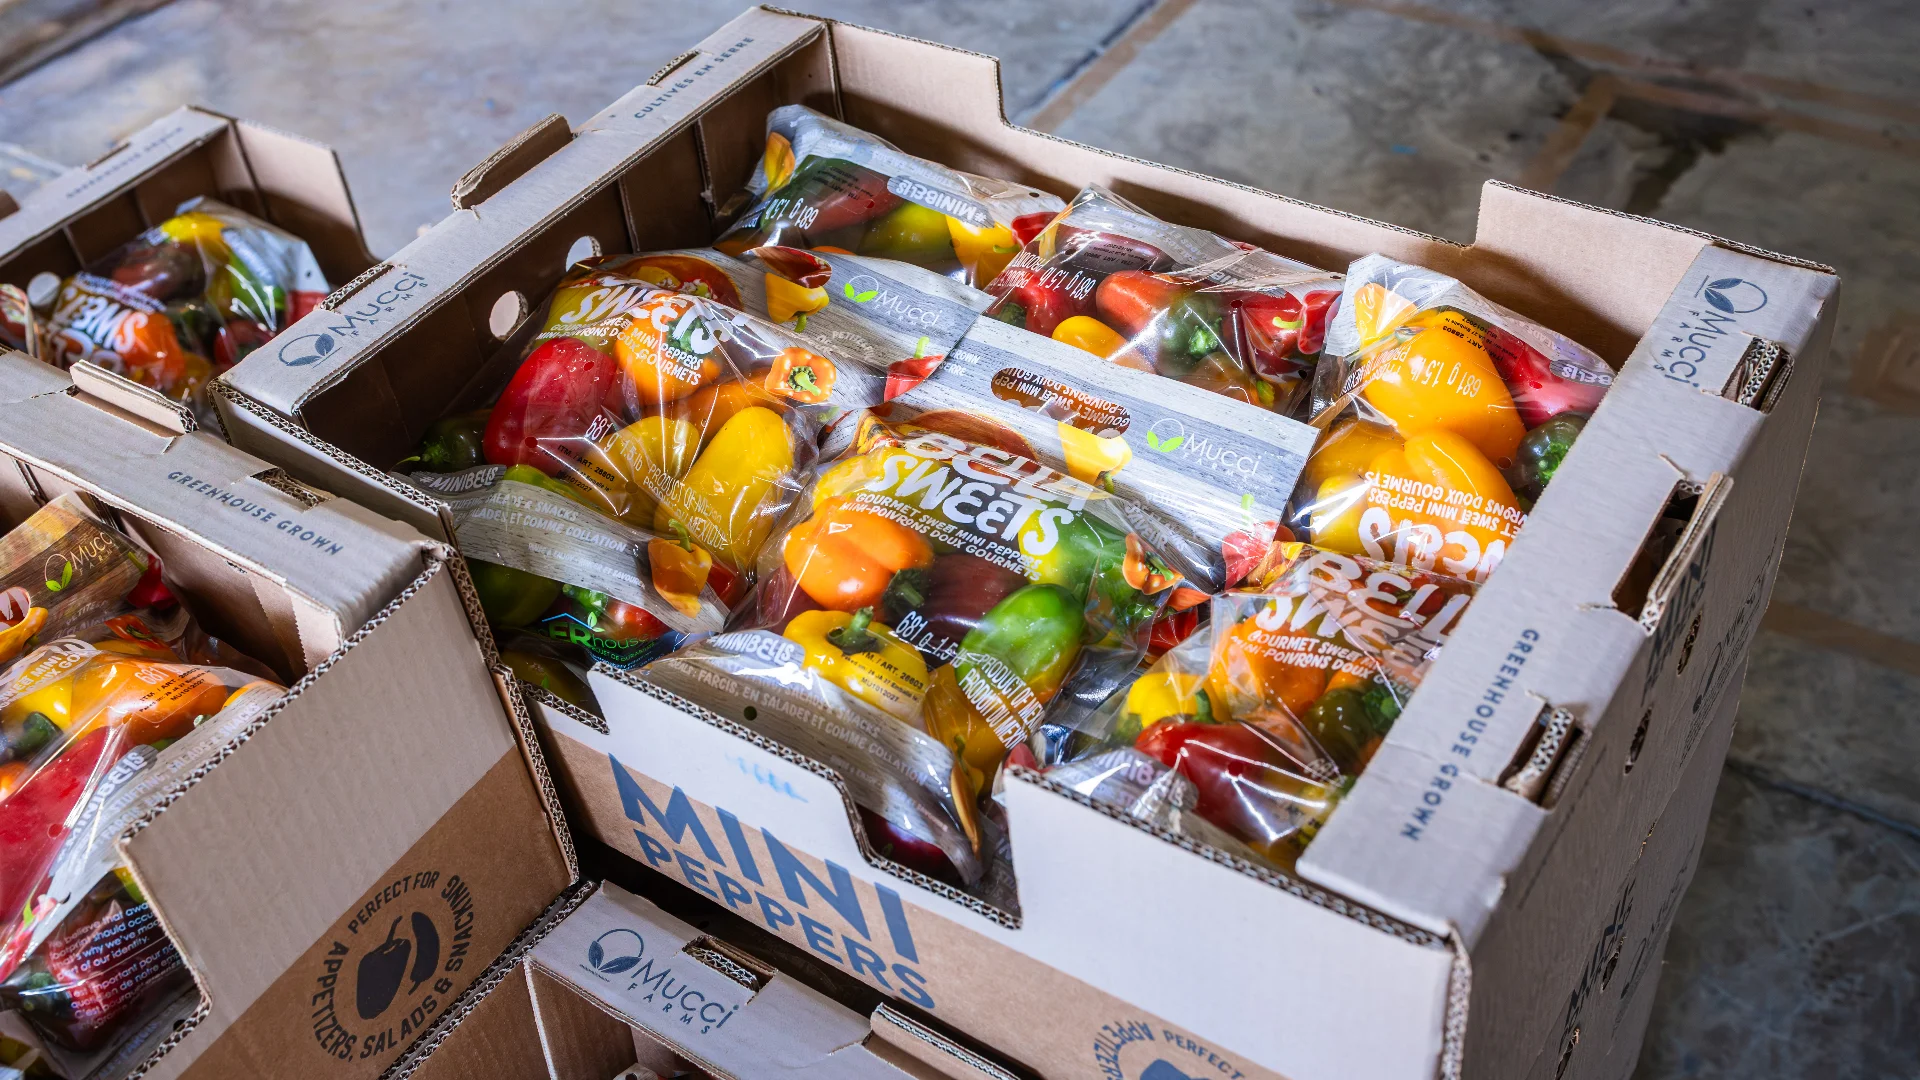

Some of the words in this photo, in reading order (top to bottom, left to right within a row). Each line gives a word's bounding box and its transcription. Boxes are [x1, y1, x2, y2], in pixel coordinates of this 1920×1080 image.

[634, 78, 694, 119] CULTIVÉS
[694, 64, 715, 77] EN
[714, 36, 755, 63] SERRE
[789, 197, 804, 220] g
[795, 203, 820, 230] 681
[1065, 271, 1083, 291] g
[1070, 278, 1097, 300] 681
[328, 272, 425, 336] Mucci
[351, 282, 428, 337] FARMS
[874, 303, 930, 330] FARMS
[875, 289, 943, 326] Mucci
[609, 326, 641, 351] DOUX
[637, 349, 702, 387] GOURMETS
[630, 327, 659, 350] MINI
[660, 343, 704, 371] PEPPERS
[1653, 310, 1700, 372] FARMS
[1664, 310, 1737, 388] Mucci
[1016, 380, 1043, 398] MINI
[1422, 360, 1447, 389] 1.5
[1448, 362, 1462, 386] g
[1456, 372, 1482, 398] 681
[1078, 404, 1131, 428] GOURMET
[584, 415, 613, 442] 681
[604, 433, 620, 452] g
[619, 438, 638, 462] 1.5
[633, 451, 643, 472] lb
[1183, 432, 1263, 476] Mucci
[419, 466, 499, 493] #MINIBELLS
[577, 456, 594, 470] ART.
[1182, 452, 1248, 482] FARMS
[1364, 470, 1445, 501] GOURMETS
[1368, 488, 1426, 513] PEPPERS
[1445, 489, 1484, 509] DOUX
[167, 471, 278, 523] GREENHOUSE
[276, 519, 345, 556] GROWN
[535, 501, 579, 522] SNACKS
[866, 455, 1075, 556] SWEETS
[1426, 501, 1459, 521] MINI
[1459, 508, 1500, 532] SWEET
[510, 513, 523, 526] ET
[523, 513, 564, 534] COMME
[565, 526, 628, 553] COLLATION
[840, 501, 930, 535] MINI-POIVRONS
[930, 529, 968, 549] DOUX
[965, 545, 1043, 582] GOURMETS
[856, 493, 921, 519] GOURMET
[922, 514, 957, 538] SWEET
[956, 529, 986, 550] MINI
[986, 541, 1043, 570] PEPPERS
[896, 611, 928, 642] 681
[706, 633, 795, 667] #MINIBELLS
[1230, 635, 1333, 670] MINI-POIVRONS
[1331, 658, 1374, 680] DOUX
[1247, 629, 1320, 653] GOURMET
[1317, 641, 1362, 665] SWEET
[31, 655, 62, 678] MINI
[135, 666, 169, 685] 681
[881, 661, 899, 677] ART.
[978, 654, 1026, 700] PRODUCT
[1010, 685, 1034, 707] OF
[1452, 628, 1541, 759] GREENHOUSE
[700, 669, 740, 698] FARCIS,
[742, 684, 761, 700] EN
[761, 691, 811, 721] SALADES
[811, 715, 825, 731] ET
[825, 723, 868, 750] COMME
[868, 743, 930, 787] COLLATION
[985, 705, 1011, 728] DU
[167, 741, 212, 773] SALADS
[218, 701, 262, 738] SNACKS
[1400, 763, 1459, 842] GROWN
[608, 752, 919, 964] MINI
[101, 910, 123, 925] that
[347, 874, 412, 935] PERFECT
[412, 870, 440, 890] FOR
[633, 828, 936, 1010] PEPPERS
[93, 924, 126, 942] should
[441, 874, 474, 973] SNACKING
[81, 958, 92, 971] of
[93, 954, 110, 967] our
[112, 935, 150, 958] identity.
[82, 944, 104, 958] why
[105, 931, 136, 949] we've
[139, 950, 161, 969] pour
[120, 979, 134, 990] de
[135, 965, 160, 983] notre
[433, 977, 453, 995] &
[631, 958, 740, 1029] Mucci
[311, 941, 358, 1062] APPETIZERS,
[627, 982, 711, 1034] FARMS
[360, 994, 438, 1060] SALADS
[1162, 1029, 1245, 1080] PERFECT
